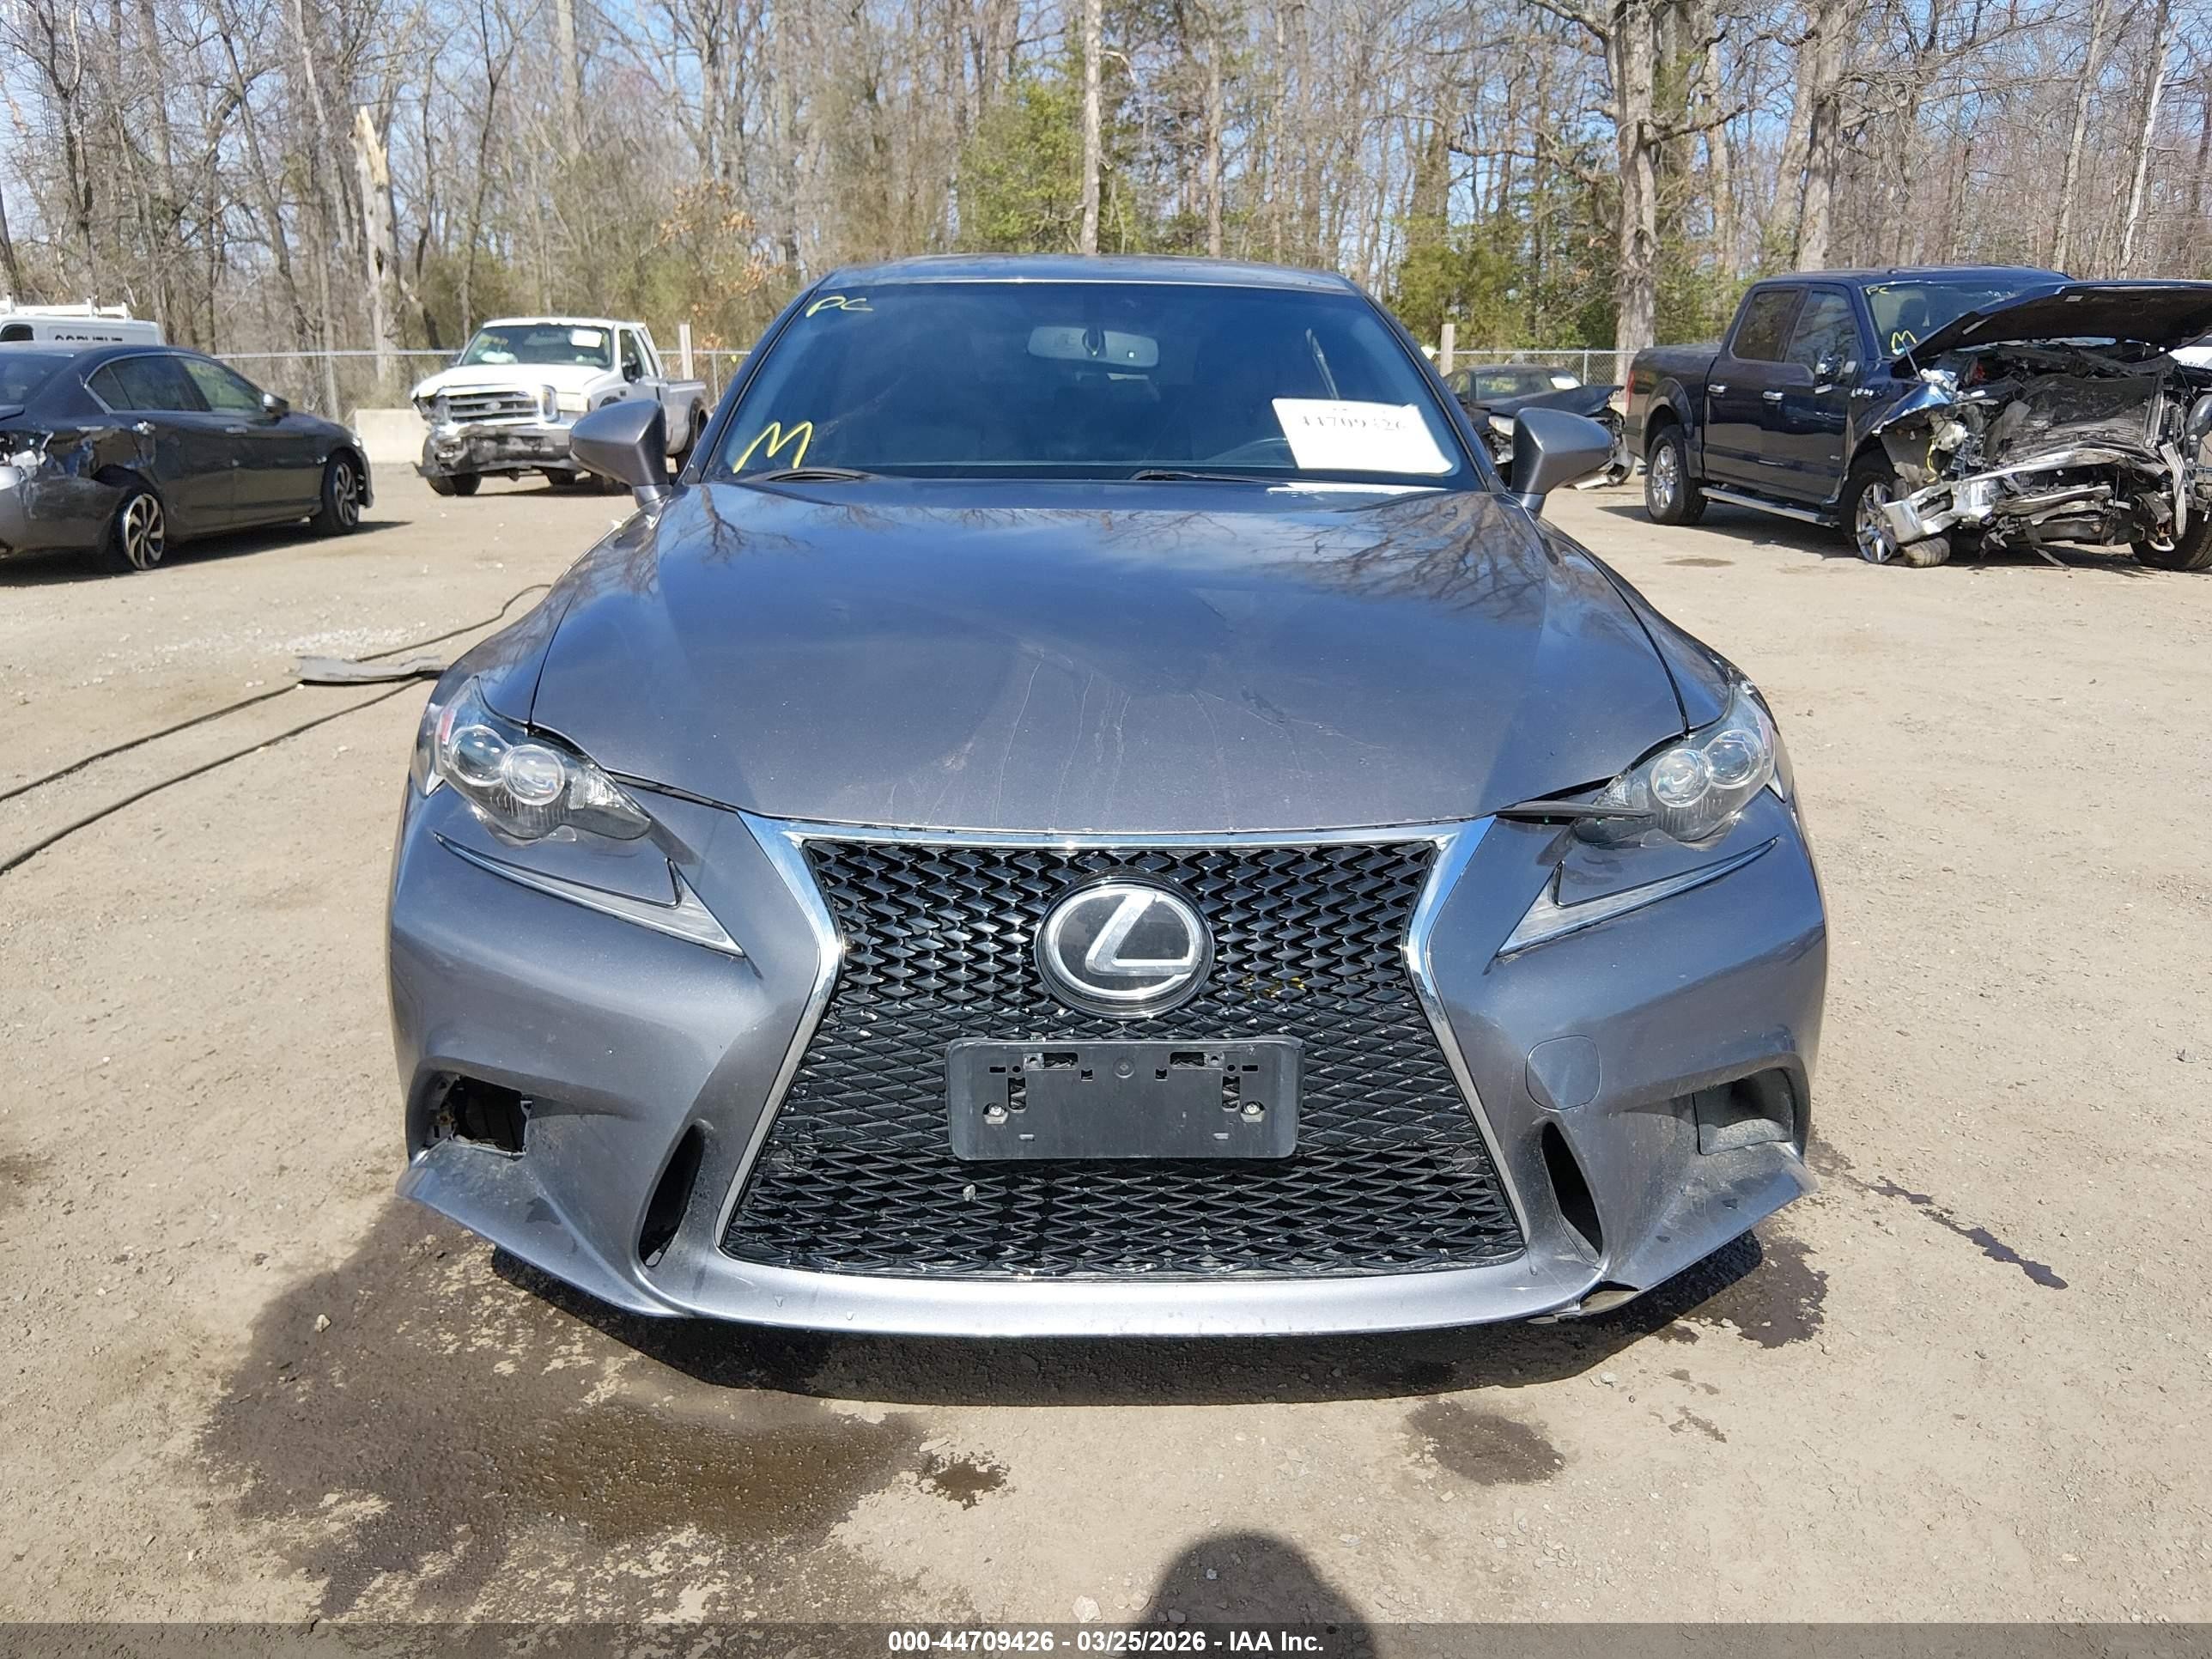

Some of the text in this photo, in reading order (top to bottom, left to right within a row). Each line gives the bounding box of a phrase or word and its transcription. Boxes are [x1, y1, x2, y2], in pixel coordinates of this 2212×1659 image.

[1865, 286, 1890, 295] PC
[1891, 330, 1917, 350] M
[732, 421, 813, 474] M
